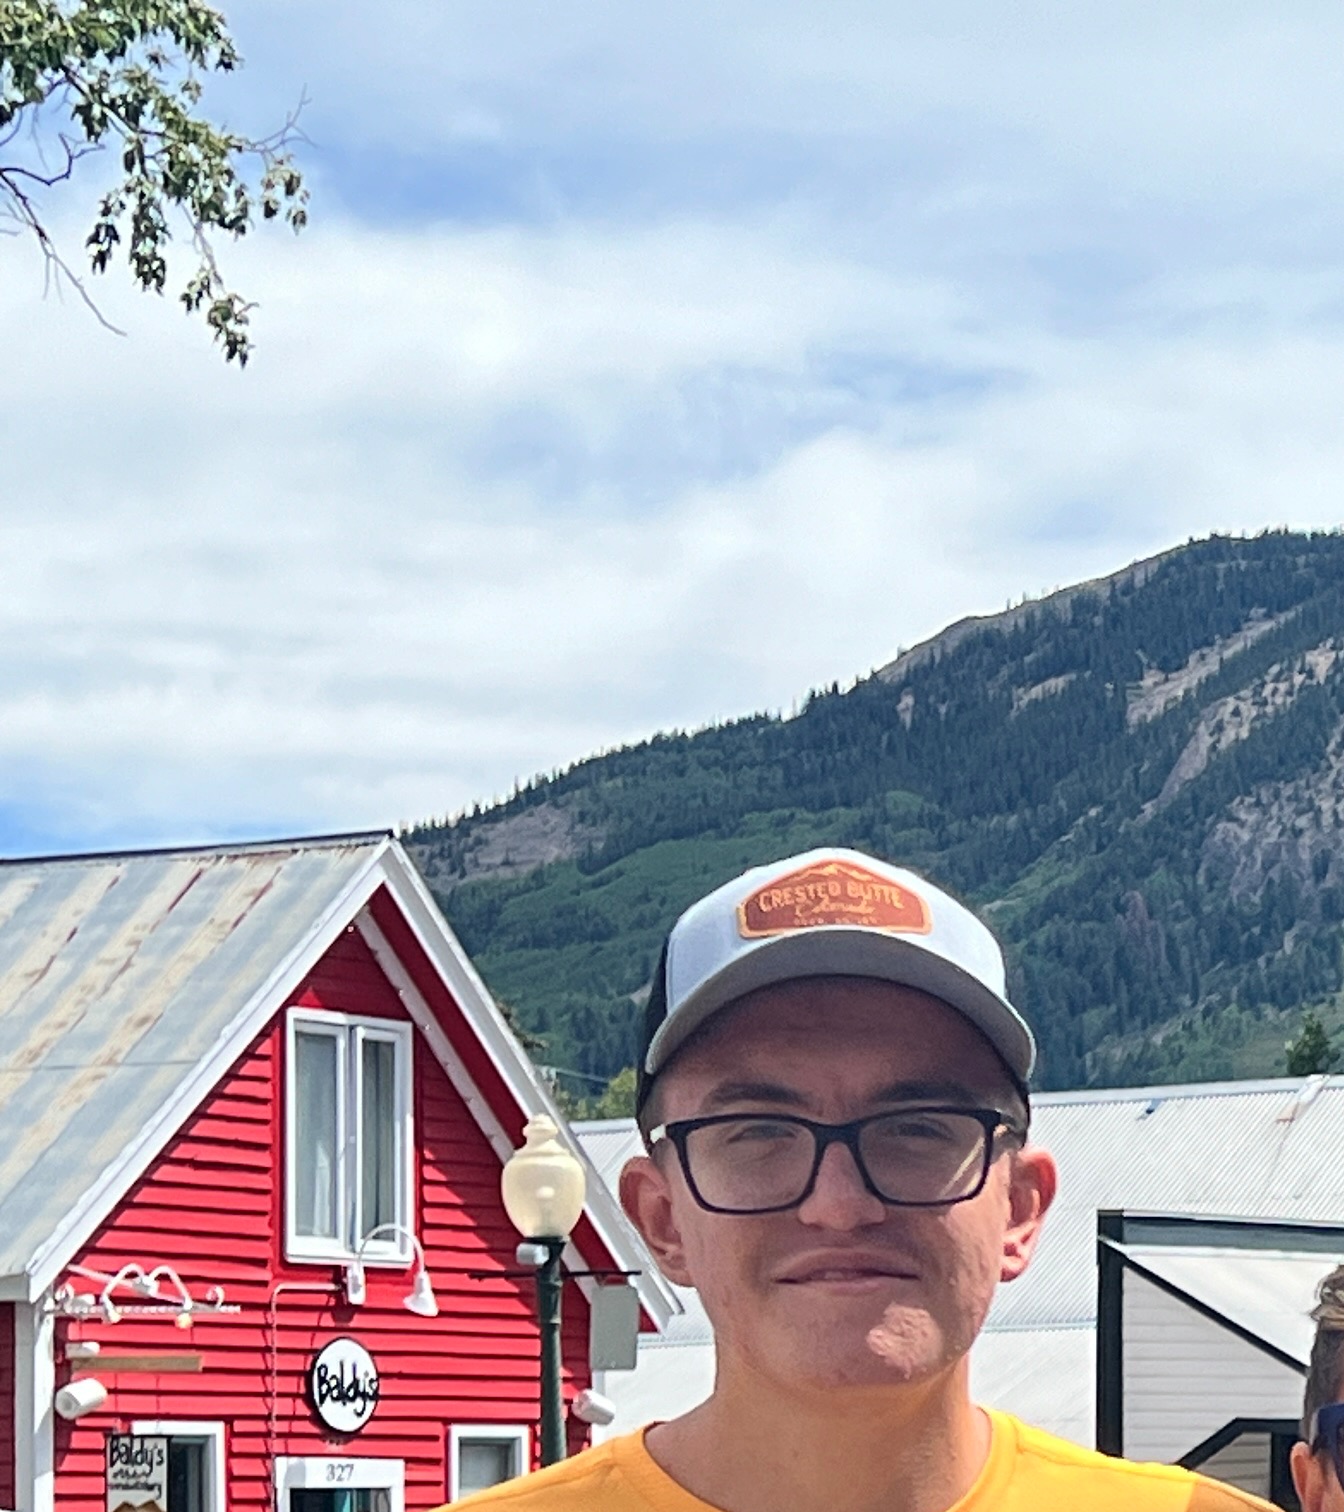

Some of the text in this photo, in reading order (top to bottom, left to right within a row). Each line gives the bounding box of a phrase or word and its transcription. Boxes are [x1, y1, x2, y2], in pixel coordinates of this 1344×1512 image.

[758, 880, 905, 912] CRESTED BUTTE
[317, 1360, 379, 1418] Baldy's
[110, 1436, 164, 1478] Baldy's
[326, 1463, 355, 1482] 327
